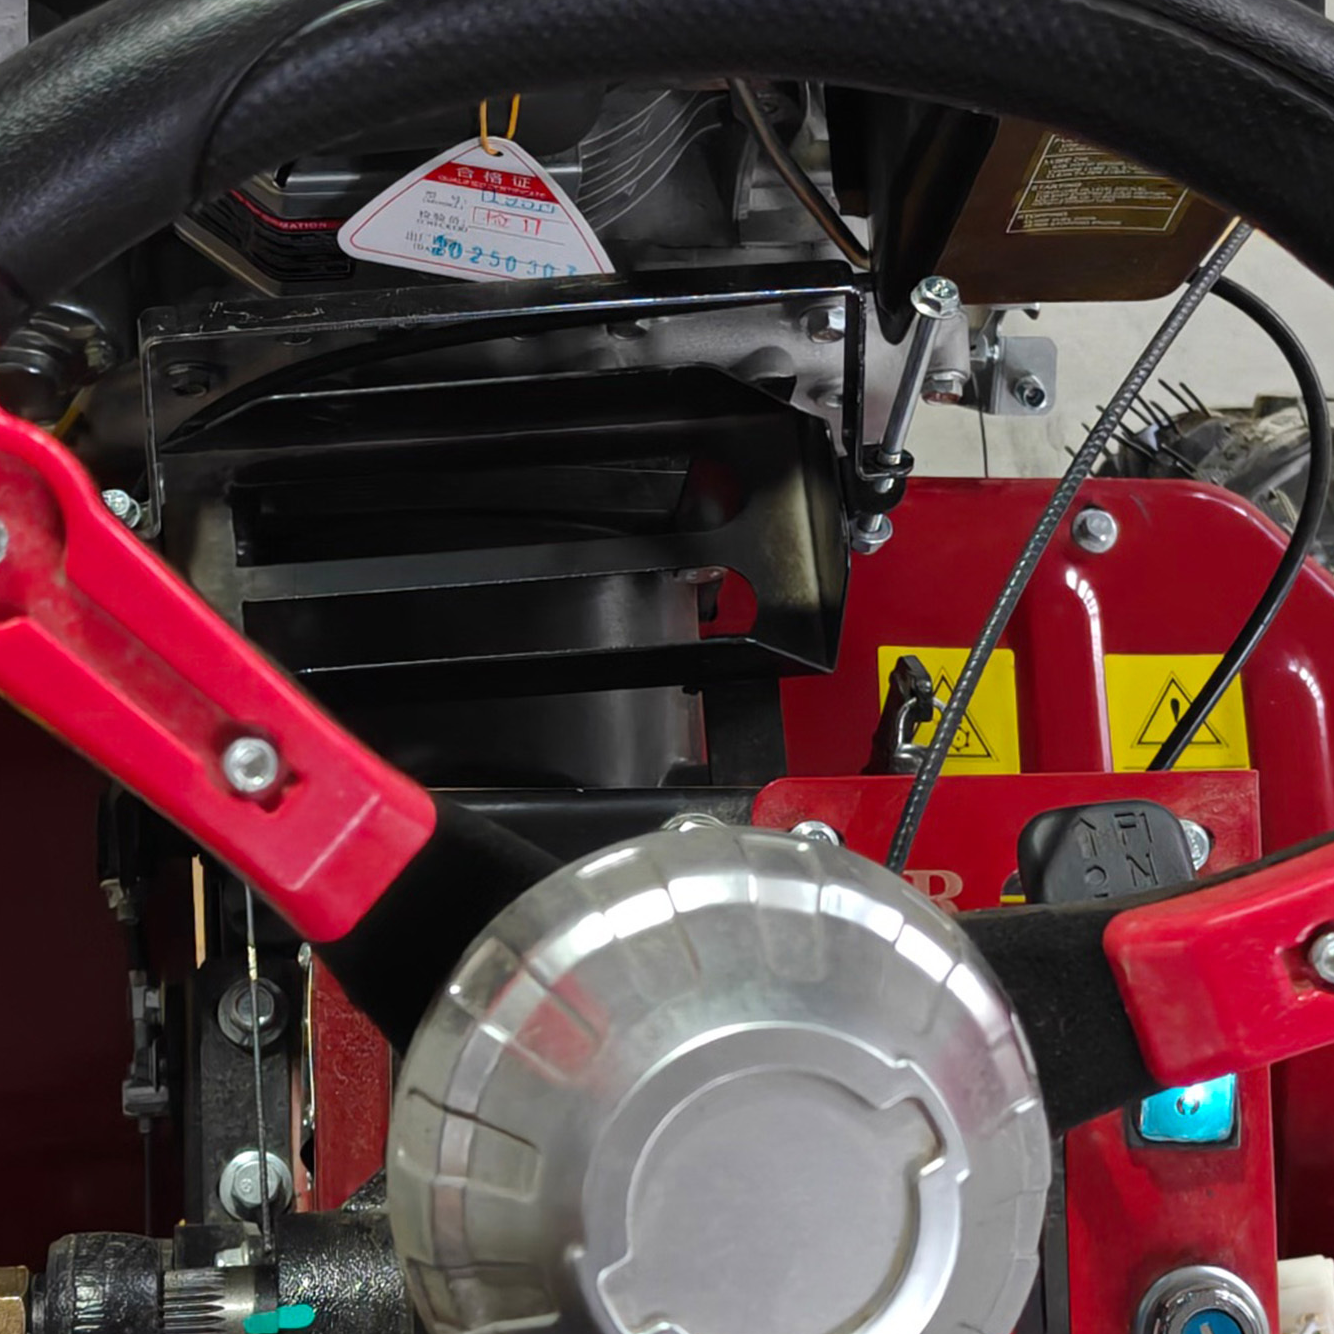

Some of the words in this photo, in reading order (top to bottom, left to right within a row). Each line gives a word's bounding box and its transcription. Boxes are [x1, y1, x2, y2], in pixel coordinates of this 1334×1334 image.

[455, 166, 532, 189] 合格证
[903, 870, 964, 915] R
